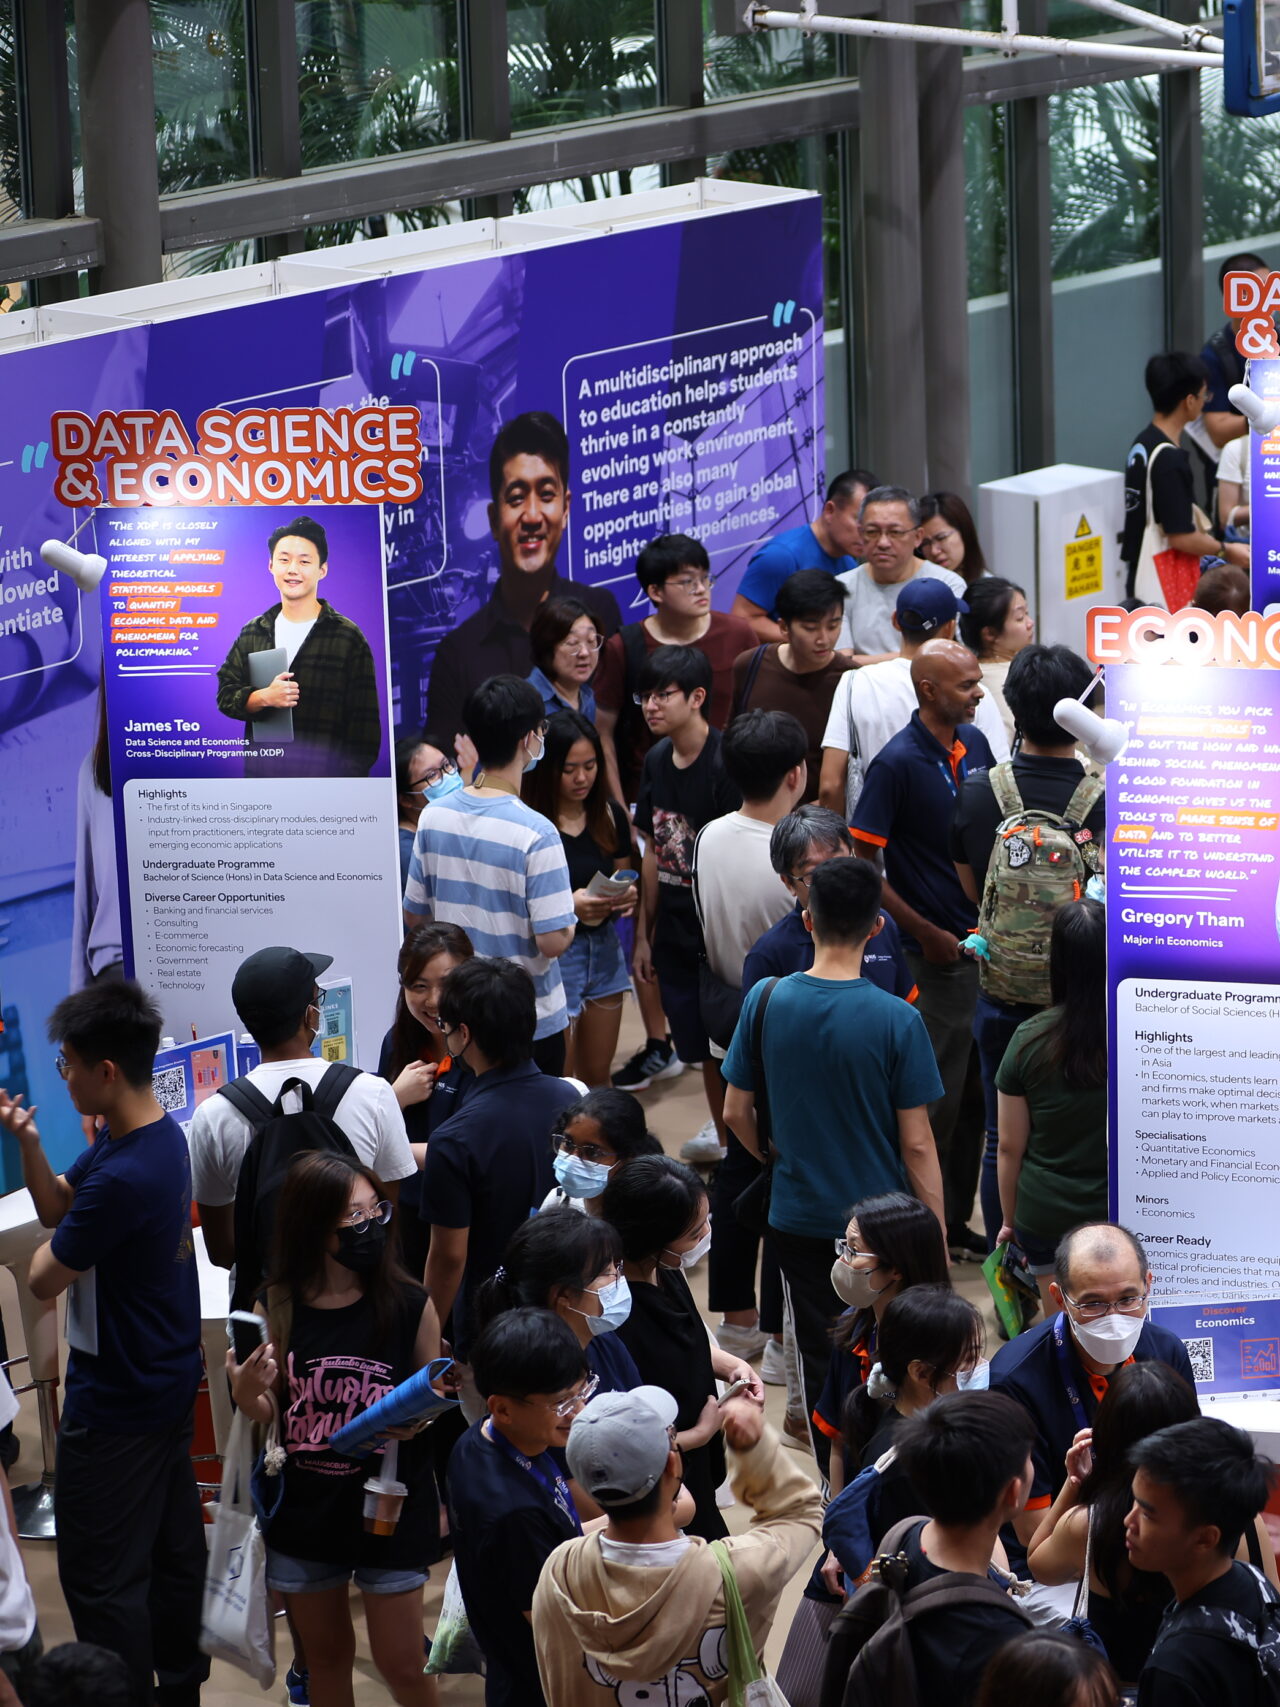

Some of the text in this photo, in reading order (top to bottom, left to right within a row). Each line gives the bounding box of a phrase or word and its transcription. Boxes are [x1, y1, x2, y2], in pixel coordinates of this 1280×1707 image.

[1242, 319, 1274, 355] &
[579, 333, 802, 399] A multidisciplinary approach
[579, 364, 797, 427] to education helps students
[58, 413, 416, 456] DATA SCIENCE
[580, 402, 746, 455] thrive in a constantly
[582, 418, 797, 484] evolving work environment.
[62, 459, 417, 500] & ECONOMICS
[583, 461, 738, 512] There are also many
[584, 469, 796, 541] opportunities to gain global
[686, 505, 779, 541] experiences.
[125, 720, 200, 732] James Teo
[125, 738, 250, 746] Data Science and Economics
[126, 748, 284, 758] Cross-Disciplinary Programme (XDP)
[138, 790, 187, 799] Highlights
[148, 803, 162, 811] The
[164, 803, 179, 811] first
[181, 803, 189, 811] of
[191, 803, 200, 811] its
[202, 802, 219, 811] kind
[230, 803, 272, 812] Singapore
[143, 860, 275, 869] Undergraduate Programme
[1121, 908, 1245, 929] Gregory Tham
[1124, 935, 1224, 948] Major in Economics
[1135, 988, 1222, 1002] Undergraduate
[1135, 1003, 1178, 1014] Bachelor
[1180, 1006, 1190, 1014] of
[1192, 1006, 1221, 1016] Social
[1223, 1007, 1267, 1018] Sciences
[1135, 1030, 1193, 1044] Highlights
[1141, 1045, 1161, 1054] One
[1164, 1046, 1174, 1054] of
[1176, 1047, 1191, 1055] the
[1194, 1048, 1226, 1058] largest
[1229, 1050, 1246, 1058] and
[1135, 1130, 1207, 1142] Specialisations
[1142, 1143, 1255, 1157] Quantitative Economics
[1136, 1195, 1169, 1204] Minors
[1135, 1233, 1211, 1248] Career Ready
[1203, 1306, 1247, 1315] Discover
[1196, 1316, 1255, 1328] Economics
